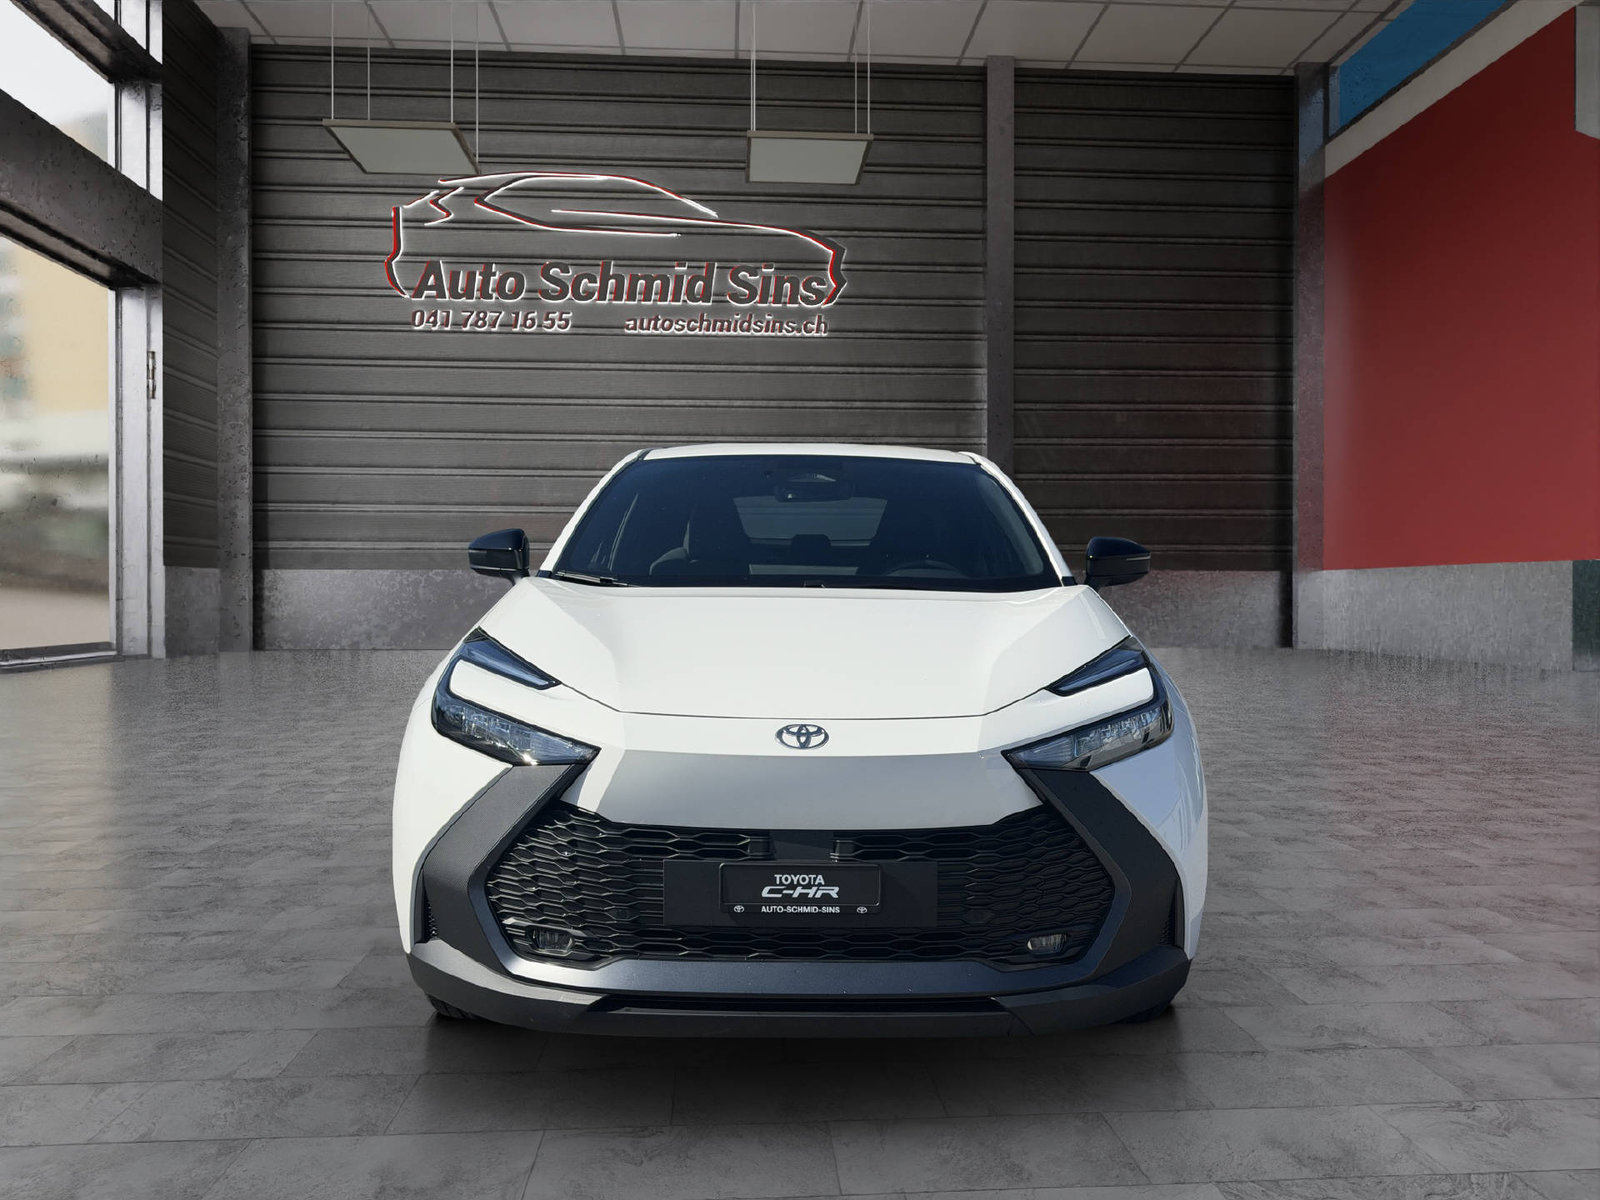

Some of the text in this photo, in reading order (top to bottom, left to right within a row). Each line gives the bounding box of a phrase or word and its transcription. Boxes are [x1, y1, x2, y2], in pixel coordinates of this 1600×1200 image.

[411, 260, 828, 307] Auto Schmid Sins
[411, 309, 573, 331] 041 787 16 55
[624, 313, 829, 336] autoschmidsins.ch
[774, 874, 825, 886] TOYOTA
[761, 886, 840, 899] C-HR
[761, 905, 840, 914] AUTO-SCHMID-SINS
